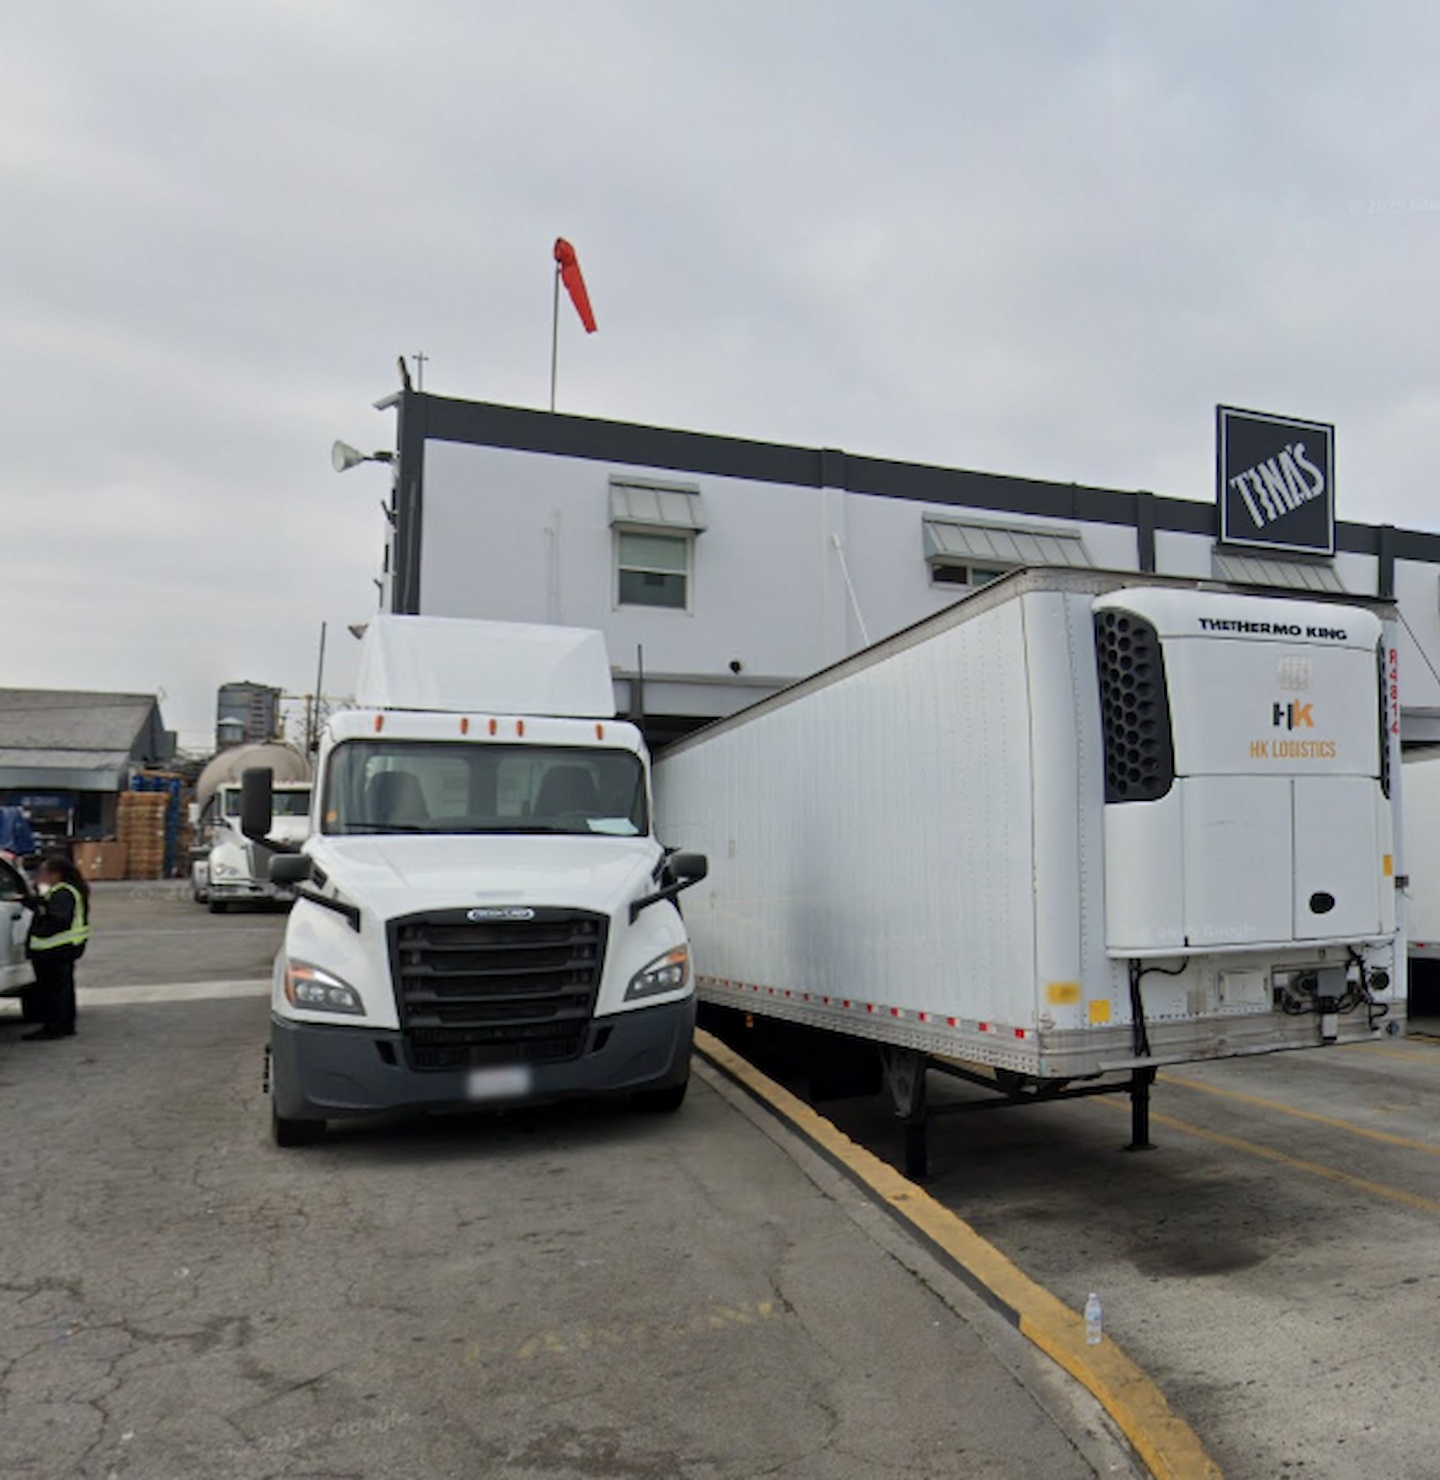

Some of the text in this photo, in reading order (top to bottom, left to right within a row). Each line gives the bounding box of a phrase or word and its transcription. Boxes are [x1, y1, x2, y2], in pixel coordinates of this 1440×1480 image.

[1229, 442, 1324, 528] TINA'S
[1306, 626, 1348, 641] KING
[1273, 700, 1314, 731] HK
[1250, 740, 1337, 759] HK LOGISTICS
